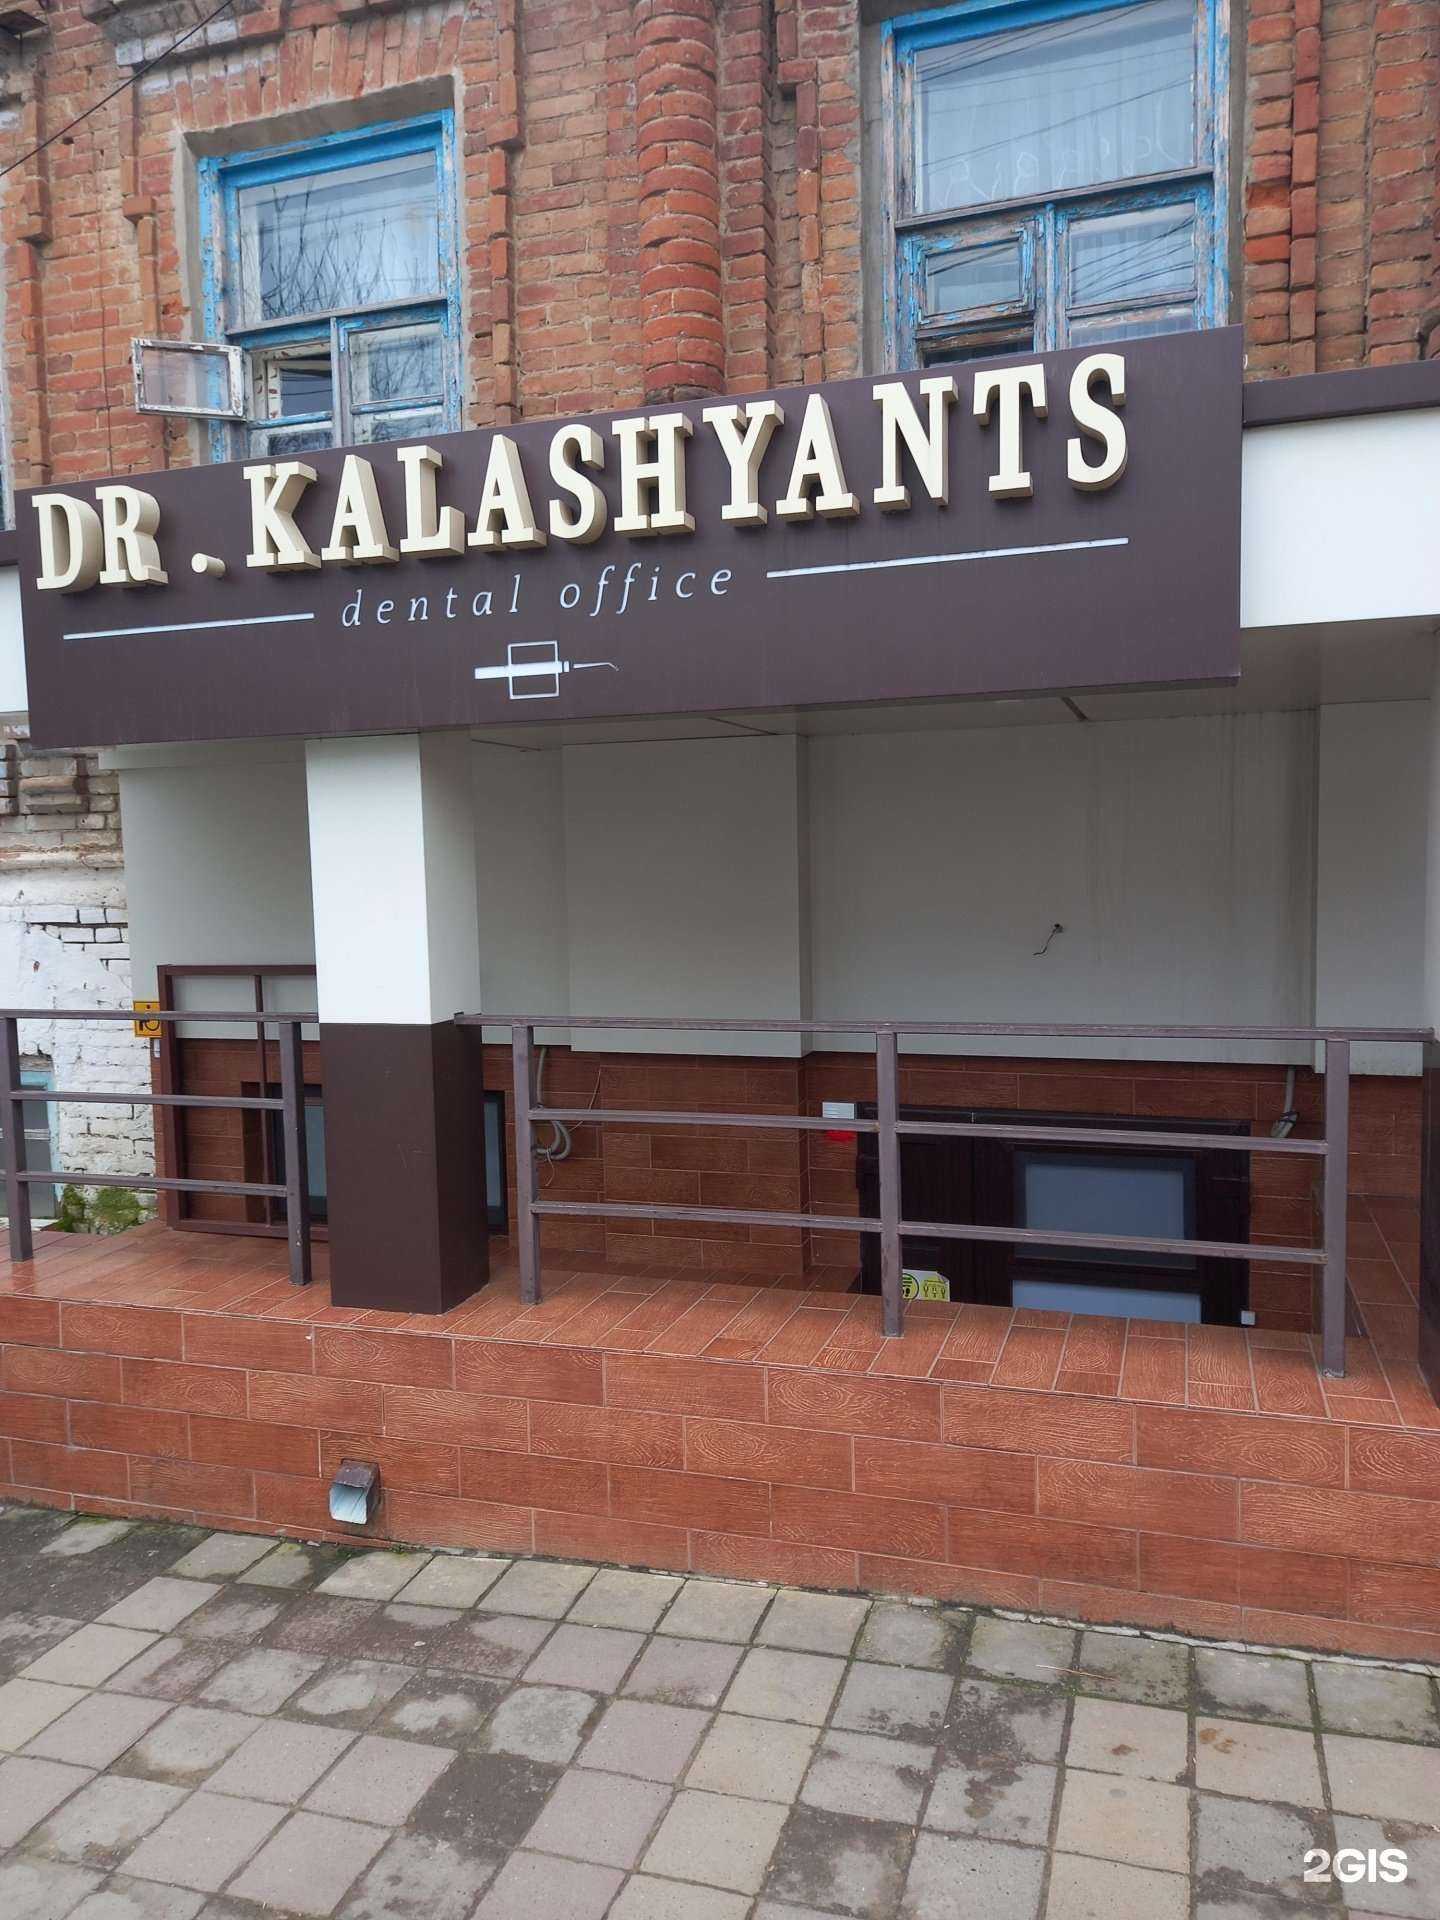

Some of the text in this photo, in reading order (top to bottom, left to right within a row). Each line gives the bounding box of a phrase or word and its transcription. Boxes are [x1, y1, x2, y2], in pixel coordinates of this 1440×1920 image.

[243, 353, 1127, 572] KALASHYANTS
[342, 562, 732, 628] dental office
